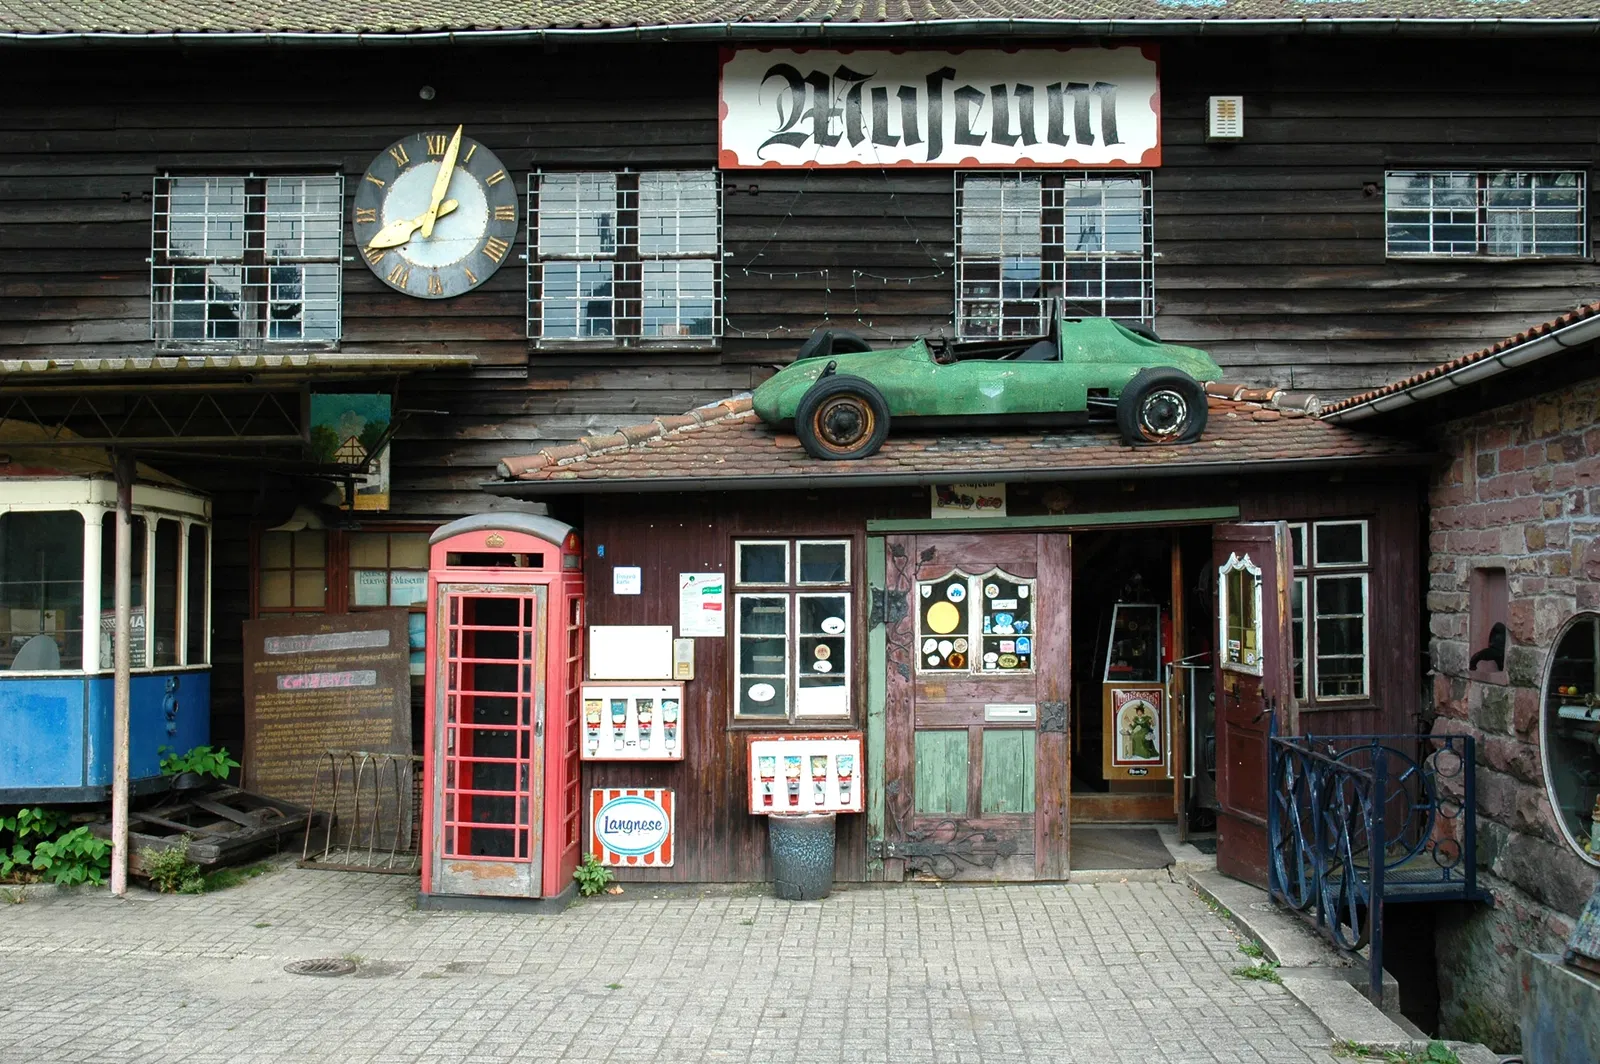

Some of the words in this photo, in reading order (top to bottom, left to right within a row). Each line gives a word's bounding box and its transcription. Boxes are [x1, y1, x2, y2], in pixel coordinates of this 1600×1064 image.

[758, 64, 1126, 162] Museum
[426, 135, 448, 156] XII
[389, 143, 410, 168] XI
[365, 172, 386, 189] X
[485, 169, 506, 188] II
[356, 206, 377, 223] IX
[494, 204, 515, 222] III
[604, 815, 663, 834] Langnese
